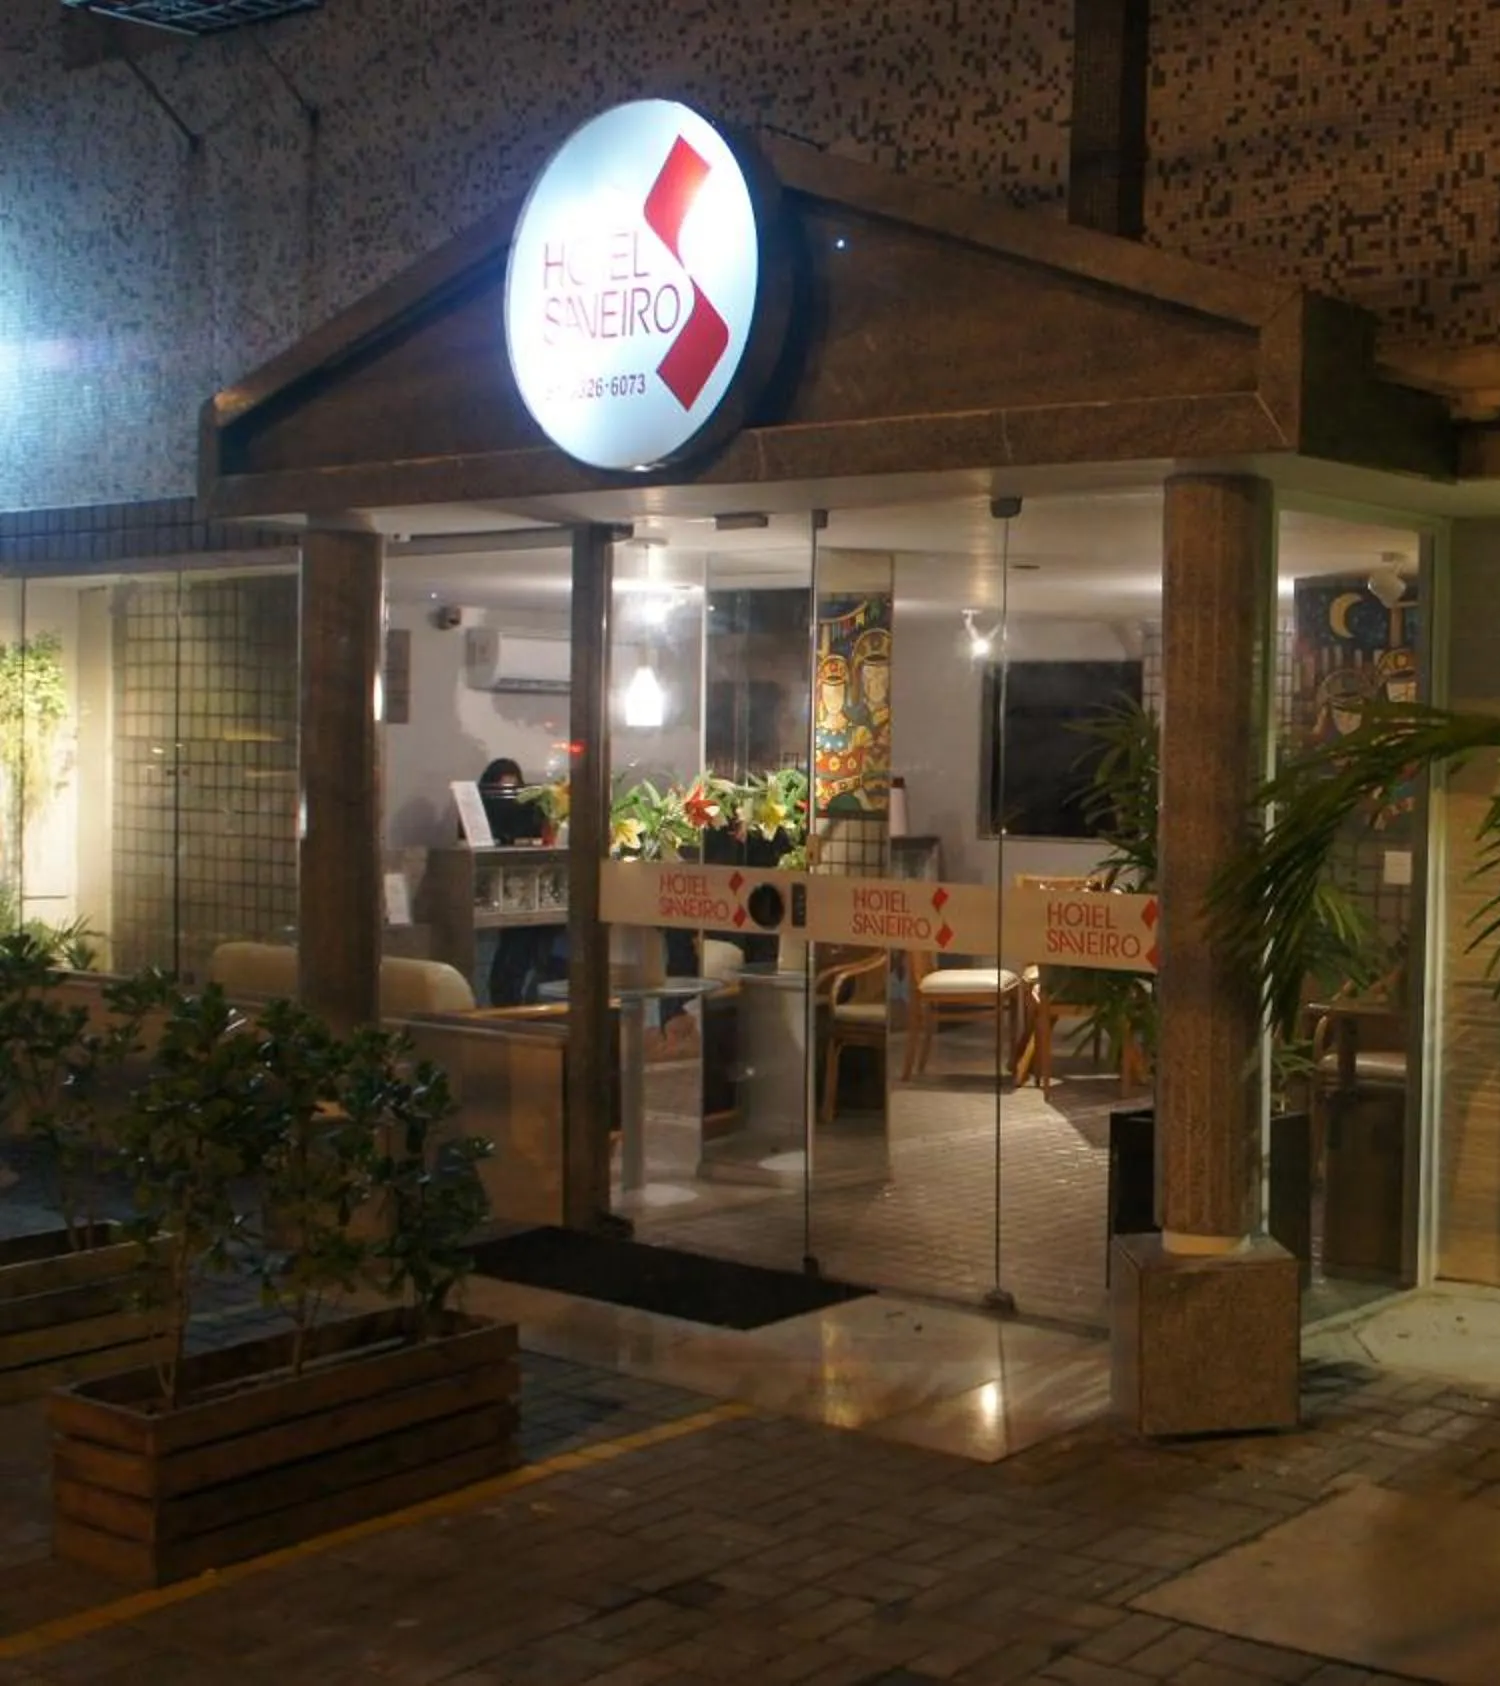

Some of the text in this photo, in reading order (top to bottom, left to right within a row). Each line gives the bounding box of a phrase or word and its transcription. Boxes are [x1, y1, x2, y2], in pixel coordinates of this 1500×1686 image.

[543, 230, 651, 290] HOEL
[543, 283, 682, 346] SAVEIRO
[660, 873, 709, 896] HOTEL
[659, 897, 730, 920] SAVEIRO
[853, 887, 911, 914] HOTEL
[852, 914, 932, 940] SAVEIRO
[1047, 901, 1117, 929] HOTEL
[1046, 929, 1141, 958] SAVEIRO
